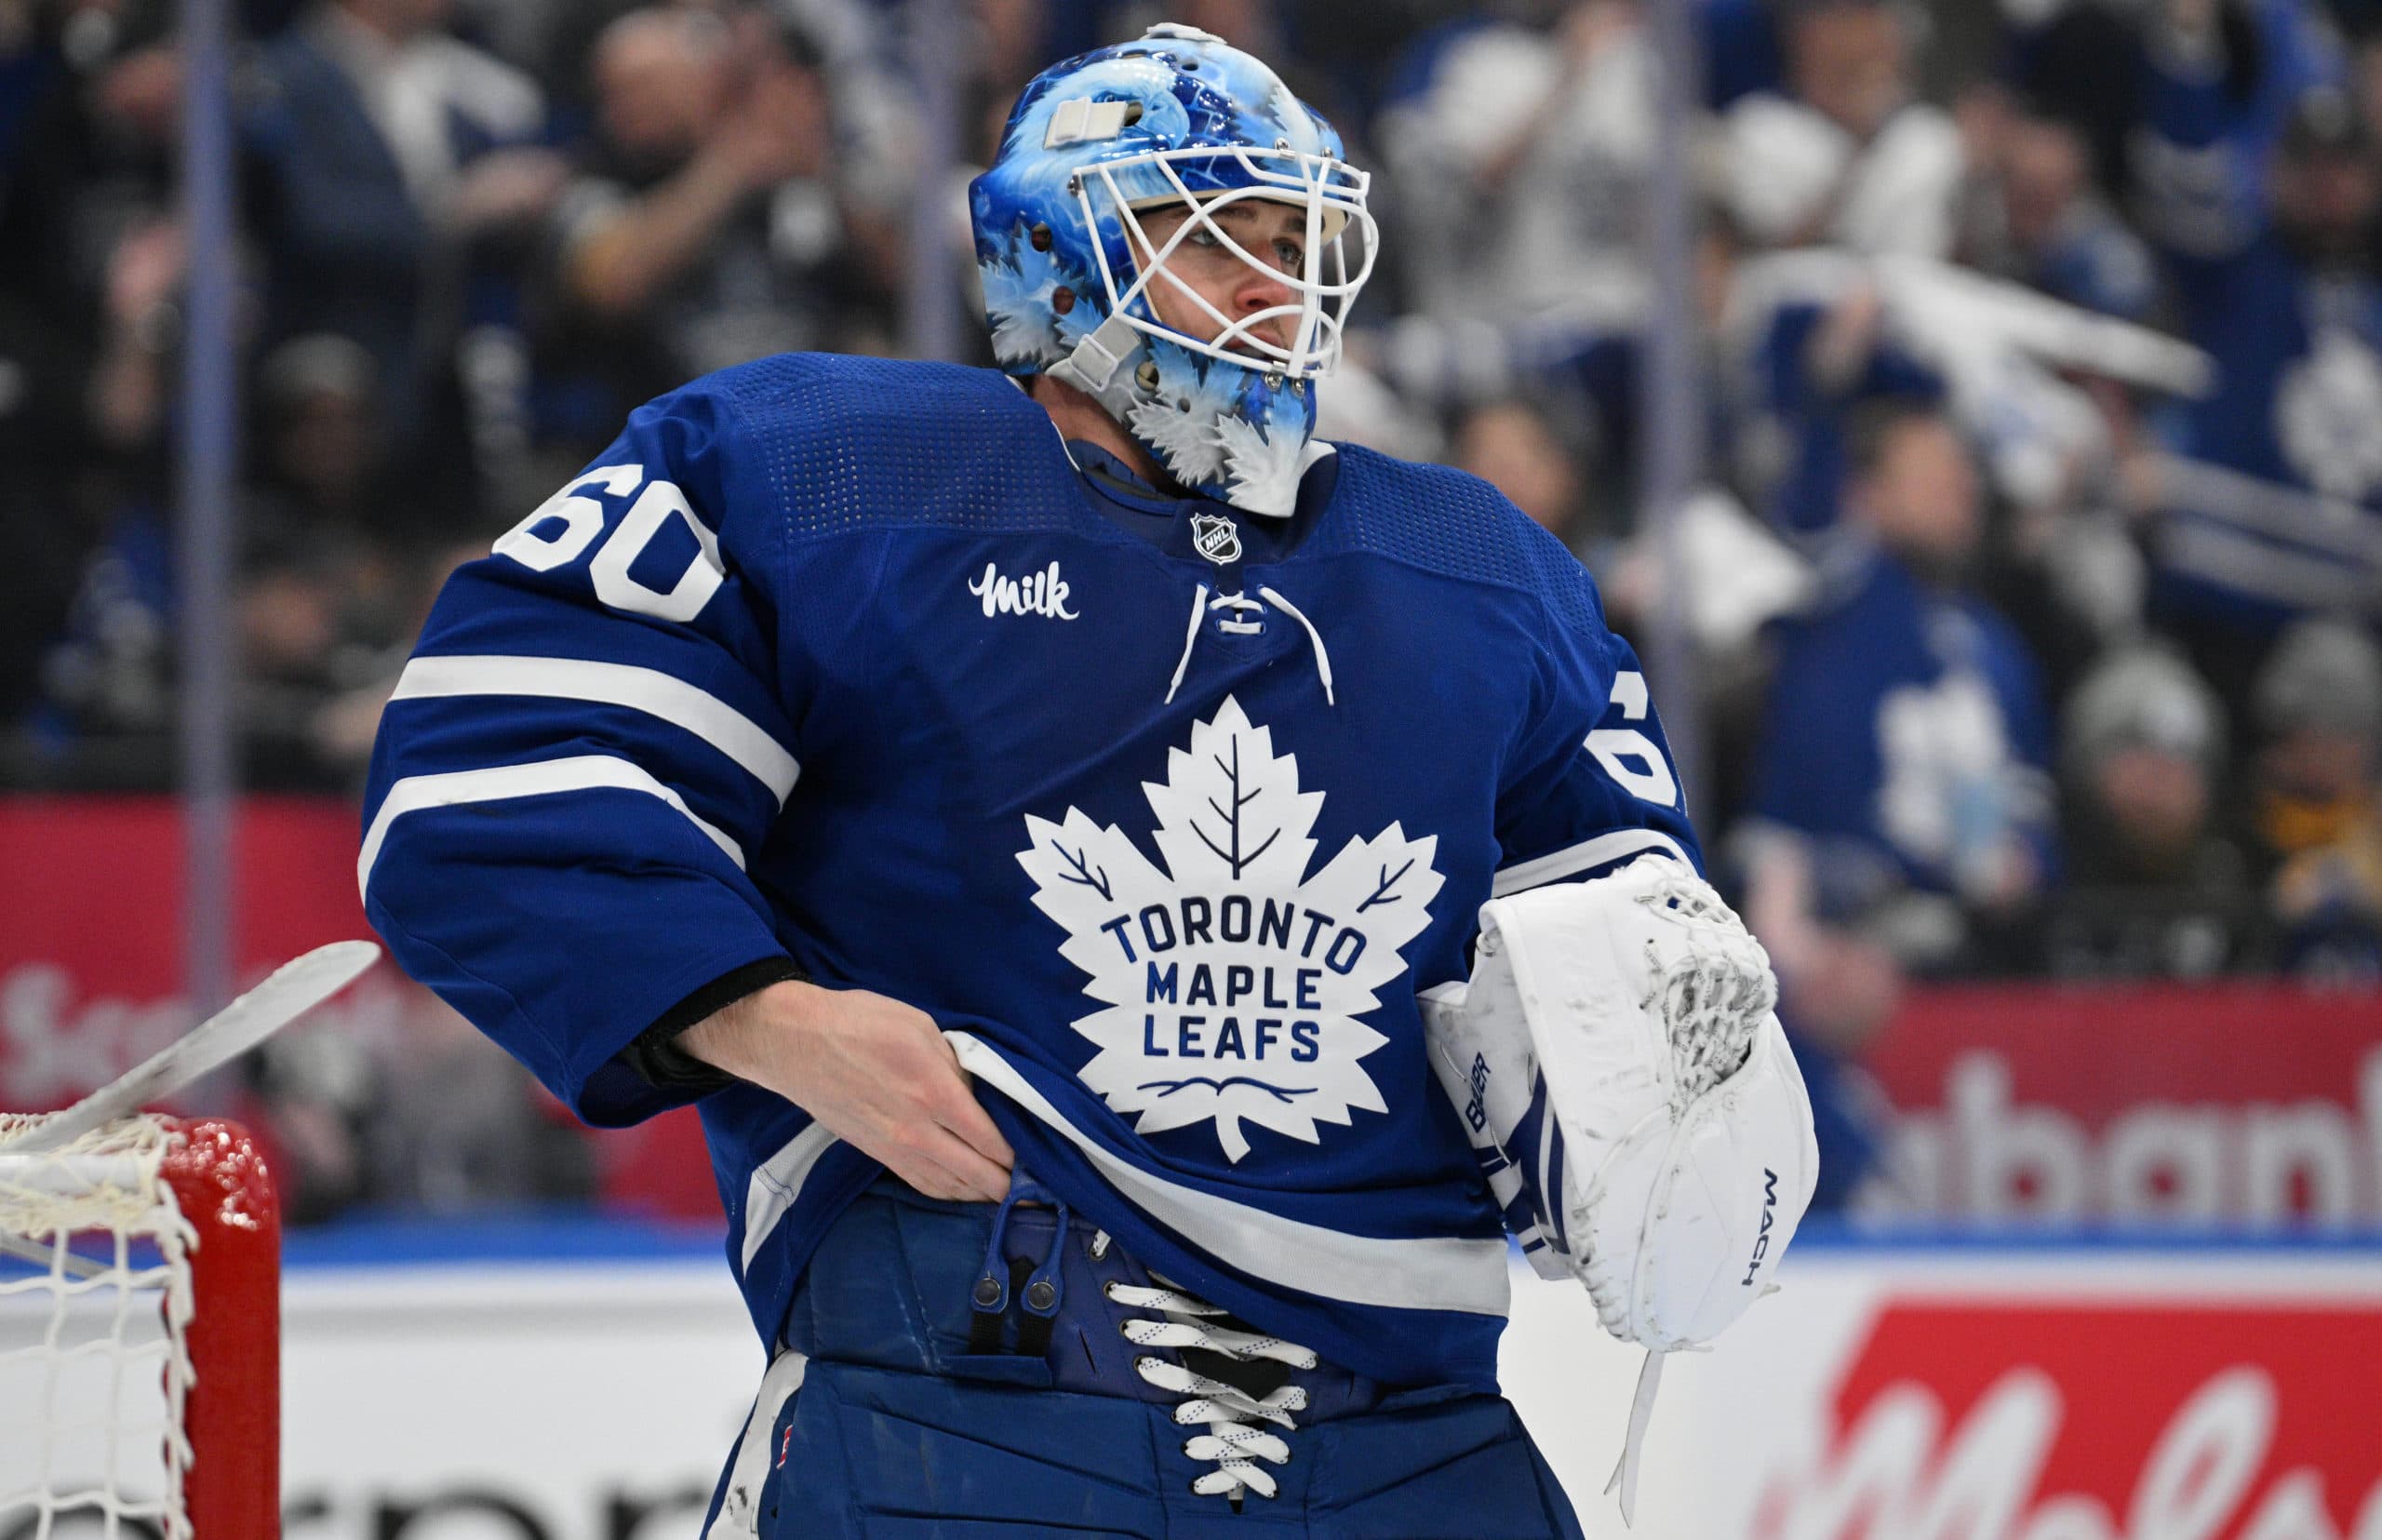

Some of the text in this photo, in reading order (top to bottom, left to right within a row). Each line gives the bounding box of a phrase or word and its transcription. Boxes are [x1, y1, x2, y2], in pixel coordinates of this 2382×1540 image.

[491, 463, 726, 622] 60
[1204, 528, 1229, 551] NHL
[968, 560, 1080, 620] Milk
[1100, 895, 1367, 975] TORONTO
[1146, 960, 1322, 1010] MAPLE
[1144, 1013, 1320, 1063] LEAFS
[1742, 1167, 1778, 1286] MACH
